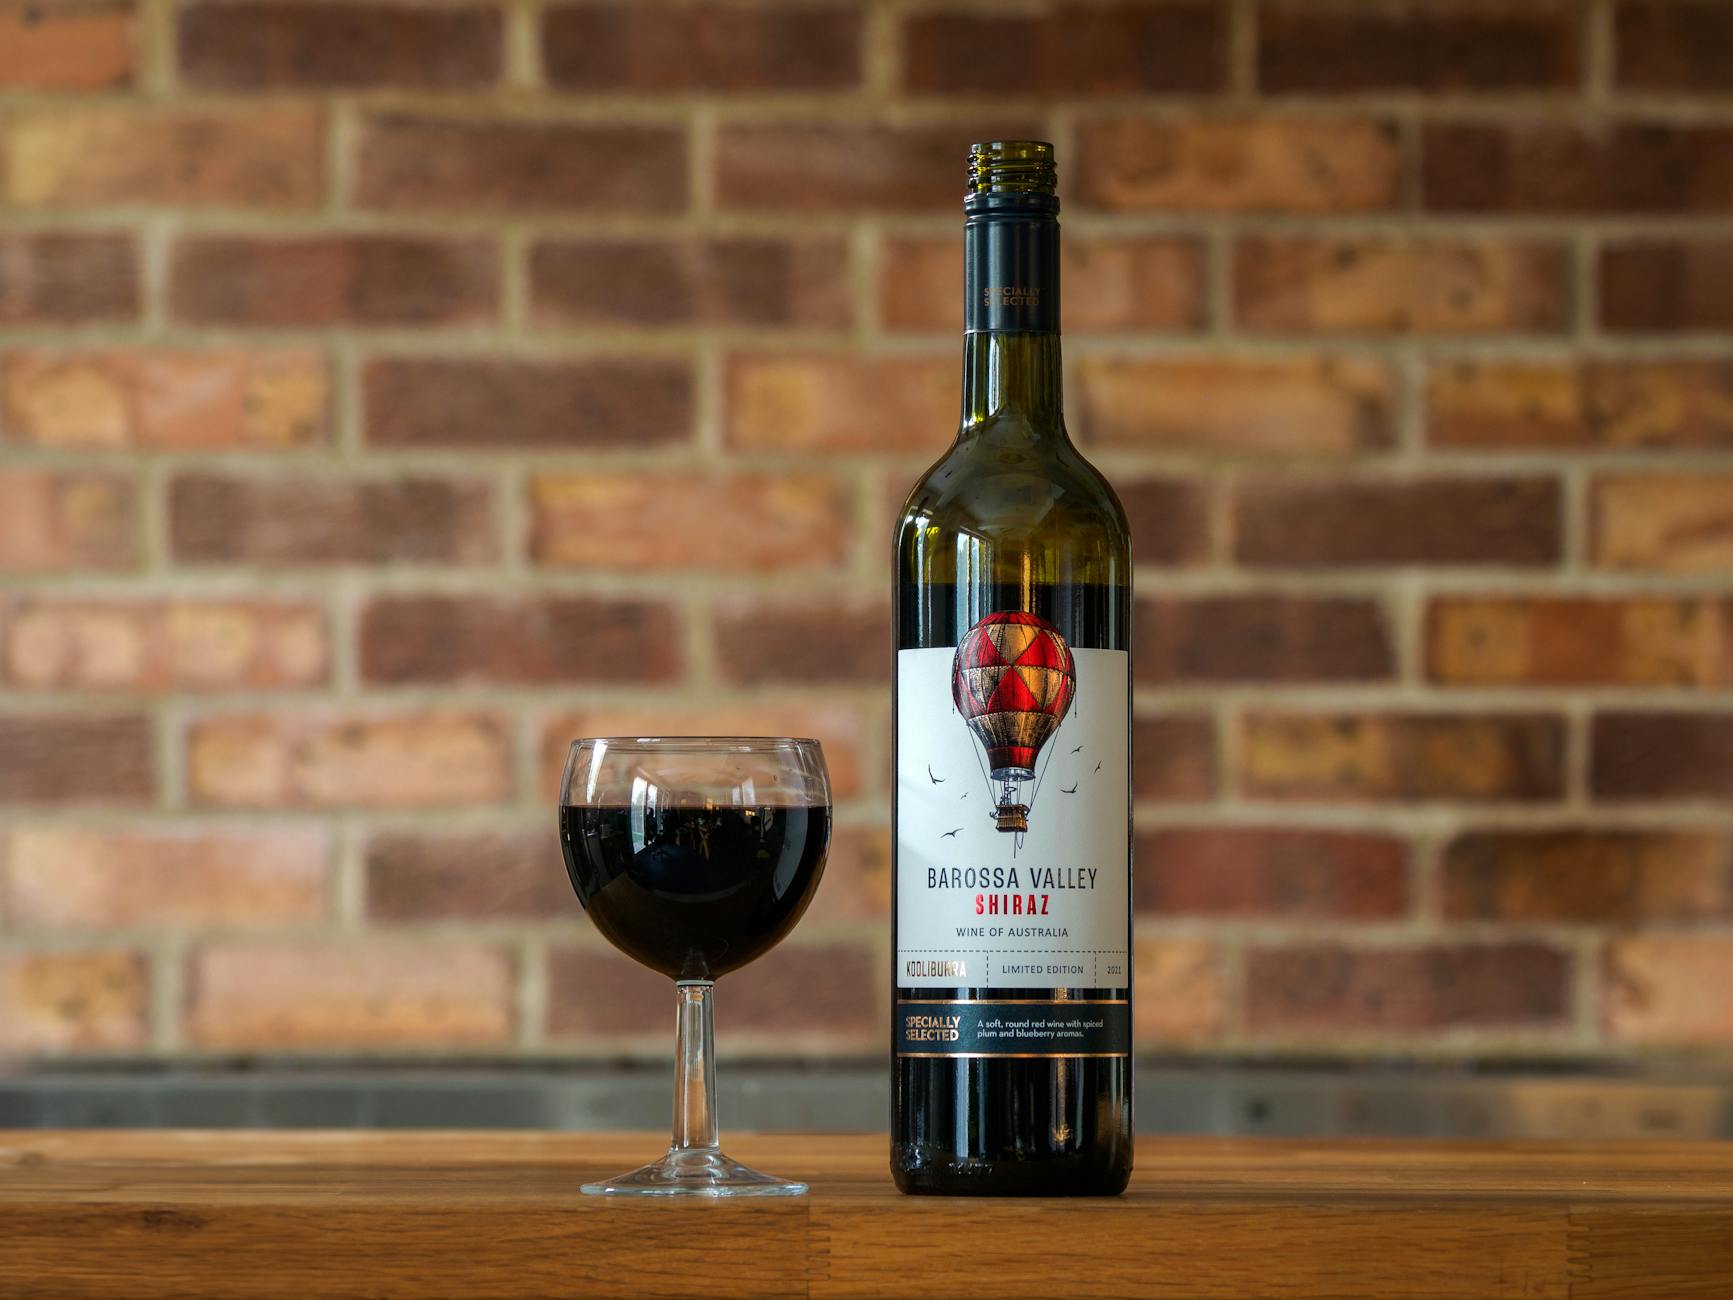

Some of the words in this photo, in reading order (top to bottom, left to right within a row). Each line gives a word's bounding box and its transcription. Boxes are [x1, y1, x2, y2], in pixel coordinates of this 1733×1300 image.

[983, 296, 1040, 306] SLECTED
[928, 868, 1020, 889] BAROSSA
[1030, 868, 1098, 889] VALLEY
[975, 894, 1049, 915] SHIRAZ
[956, 927, 985, 937] WINE
[989, 927, 1004, 937] OF
[1008, 927, 1069, 938] AUSTRALIA
[906, 960, 967, 977] KOOLIBURRA
[1002, 965, 1043, 974] LIMITED
[1047, 965, 1084, 974] EDITION
[1107, 966, 1121, 975] 2021
[906, 1016, 961, 1028] SPECIALLY
[977, 1020, 984, 1028] A
[986, 1019, 1003, 1029] soft,
[1005, 1019, 1029, 1028] round
[1032, 1019, 1046, 1028] red
[1047, 1020, 1064, 1028] wine
[1066, 1019, 1081, 1028] with
[1083, 1019, 1104, 1030] spiced
[906, 1030, 959, 1041] SELECTED
[977, 1028, 996, 1040] plum
[998, 1029, 1014, 1038] and
[1016, 1029, 1054, 1040] blueberry
